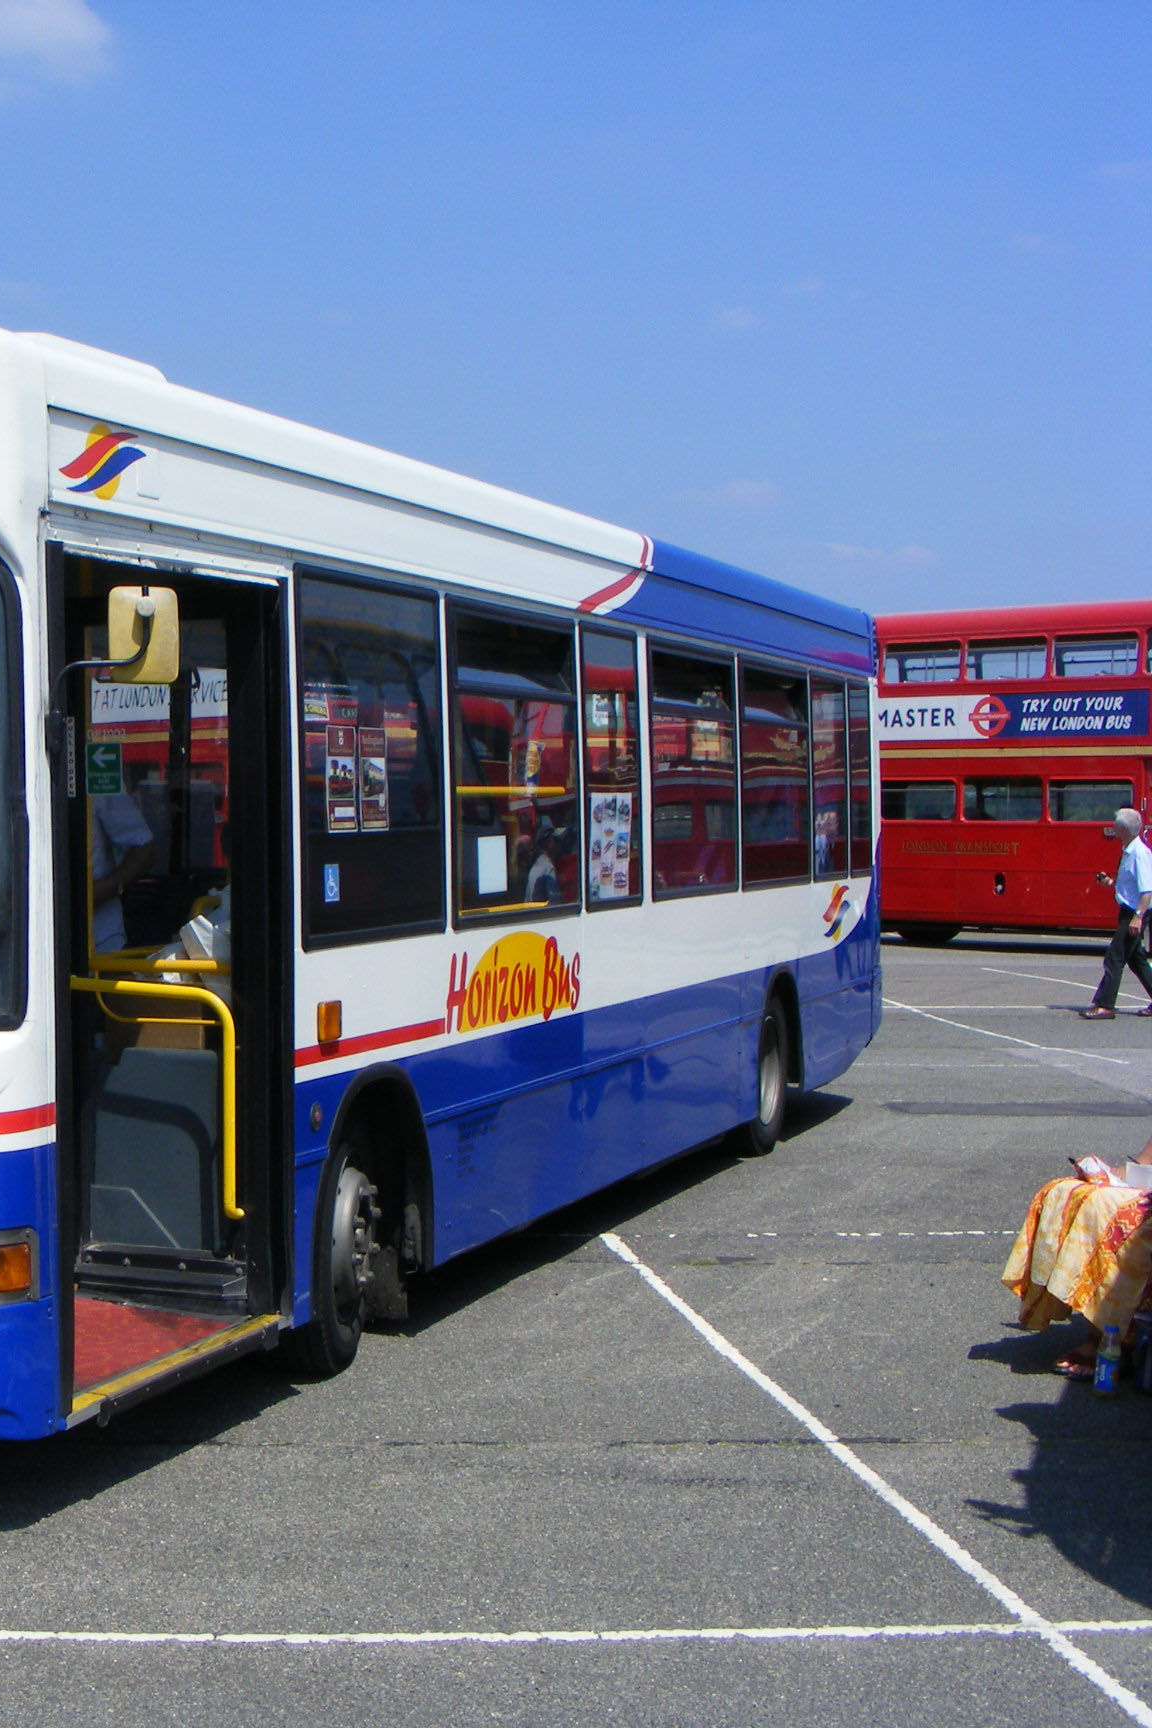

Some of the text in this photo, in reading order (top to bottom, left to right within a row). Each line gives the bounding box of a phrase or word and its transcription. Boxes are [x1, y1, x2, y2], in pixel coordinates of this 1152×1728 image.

[119, 685, 167, 709] LONDON
[1022, 696, 1124, 713] TRY OUT YOUR
[1020, 715, 1132, 732] NEW LONDON BUS
[901, 839, 1019, 856] LONDON TRANSPORT
[446, 936, 581, 1034] Horizon Bus
